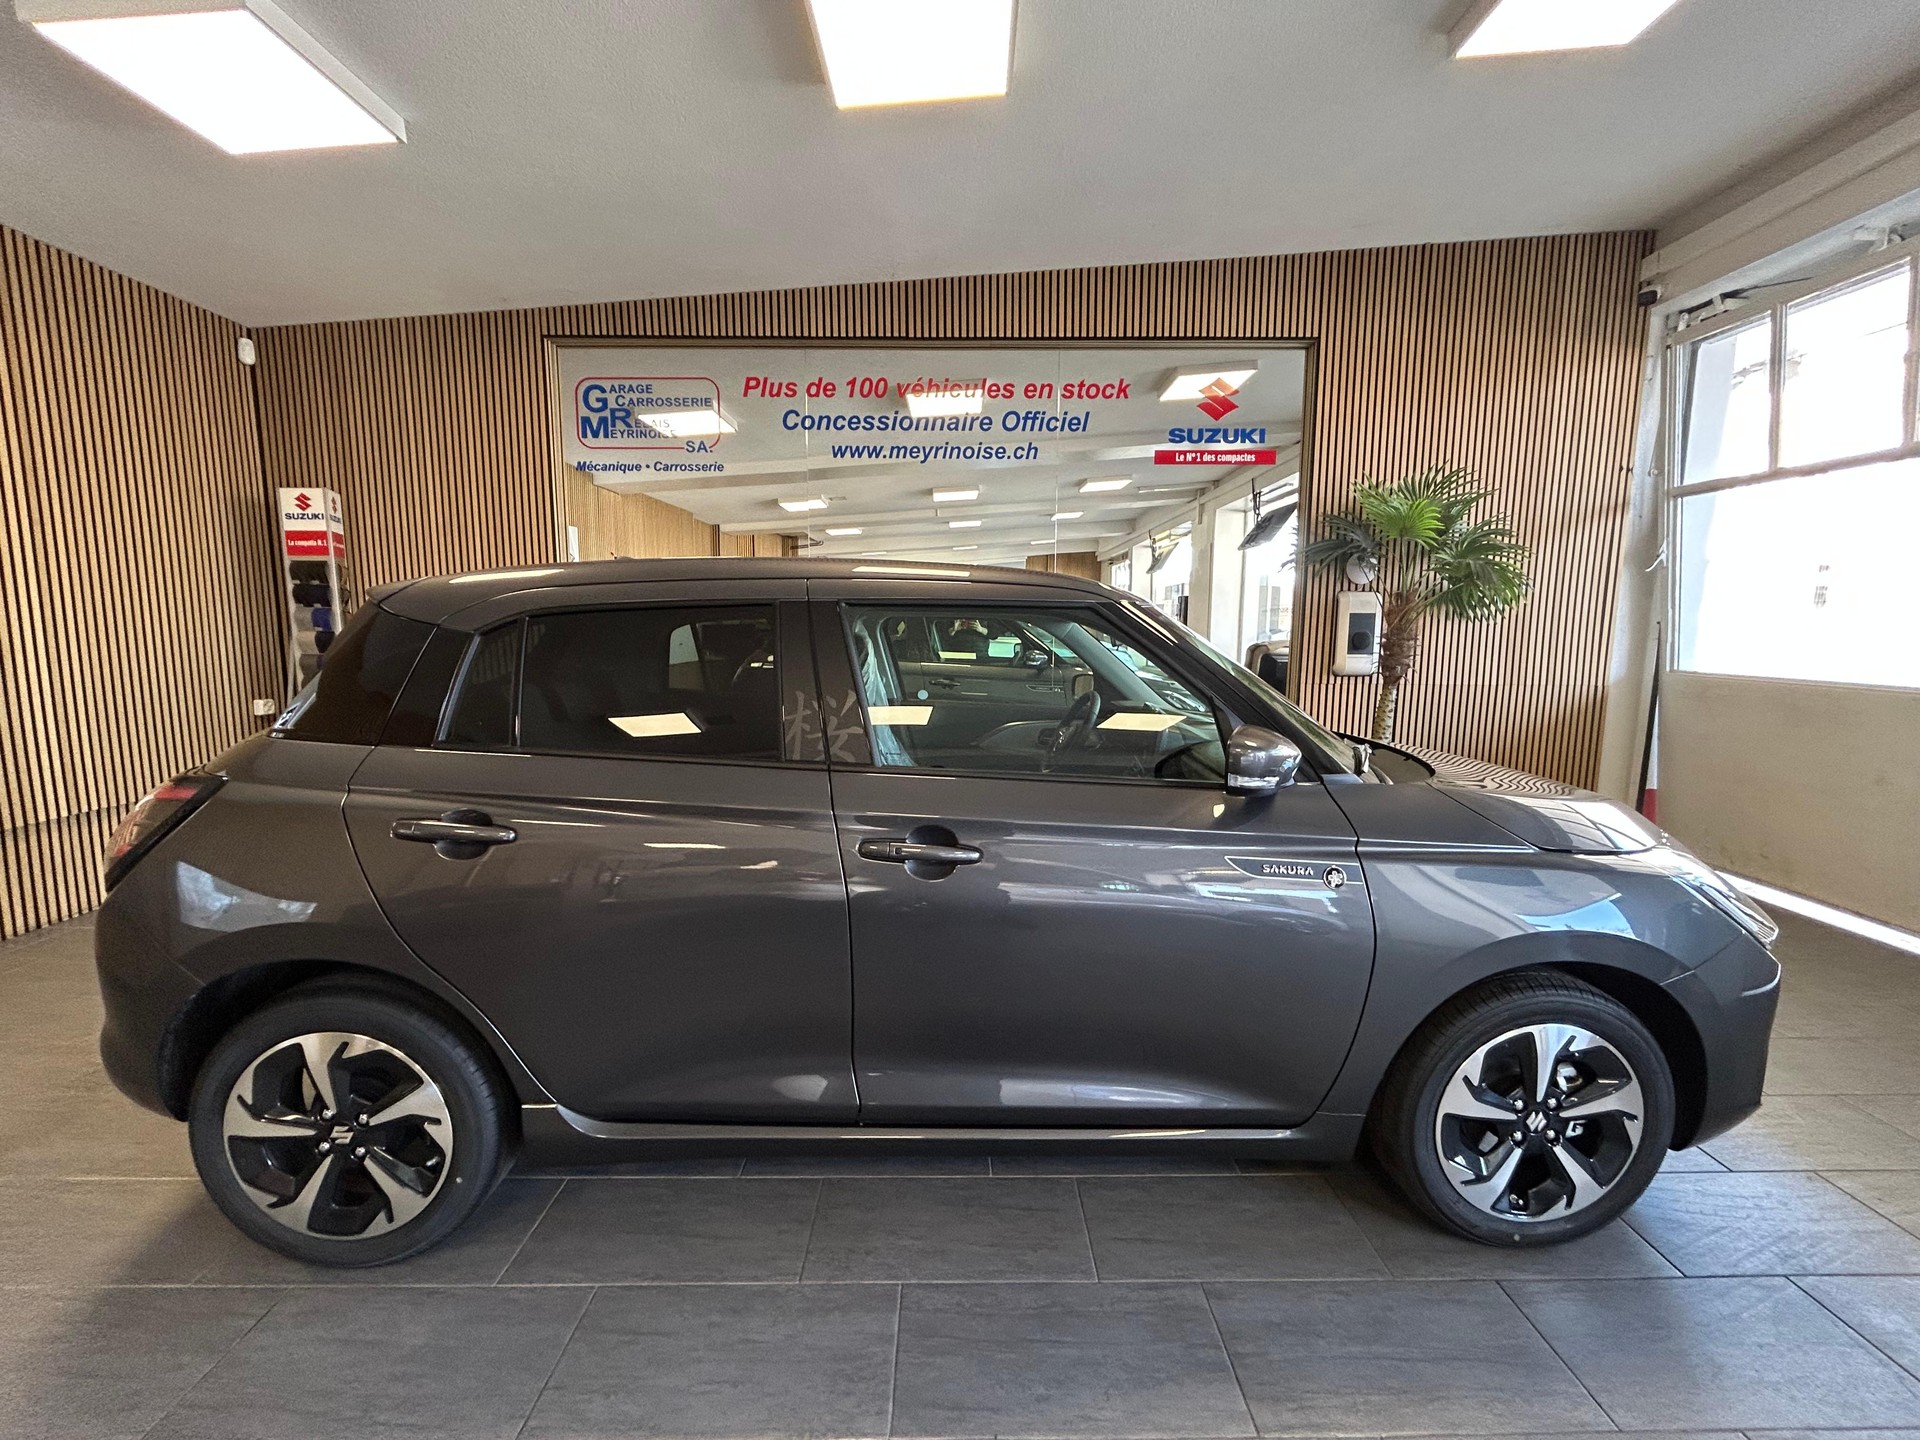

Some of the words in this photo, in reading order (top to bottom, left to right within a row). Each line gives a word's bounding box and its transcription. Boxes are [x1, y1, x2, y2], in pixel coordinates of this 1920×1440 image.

[743, 376, 798, 398] Plus
[806, 377, 836, 398] de
[846, 377, 888, 398] 100
[896, 376, 1015, 399] véhicules
[1023, 383, 1053, 399] en
[1061, 378, 1131, 400] stock
[582, 384, 653, 413] GARAGE
[615, 395, 712, 407] CARROSSERIE
[782, 409, 993, 432] Concessionnaire
[1001, 410, 1090, 432] Officiel
[1168, 428, 1266, 444] SUZUKI
[831, 442, 1038, 464] www.meyrinoise.ch
[1175, 453, 1185, 462] Le
[1202, 452, 1216, 462] des
[1217, 453, 1256, 464] compactes
[575, 461, 642, 474] Mécanique
[653, 461, 725, 472] Carrosserie
[284, 512, 325, 520] SUZUKI
[1261, 864, 1315, 876] SAKURA
